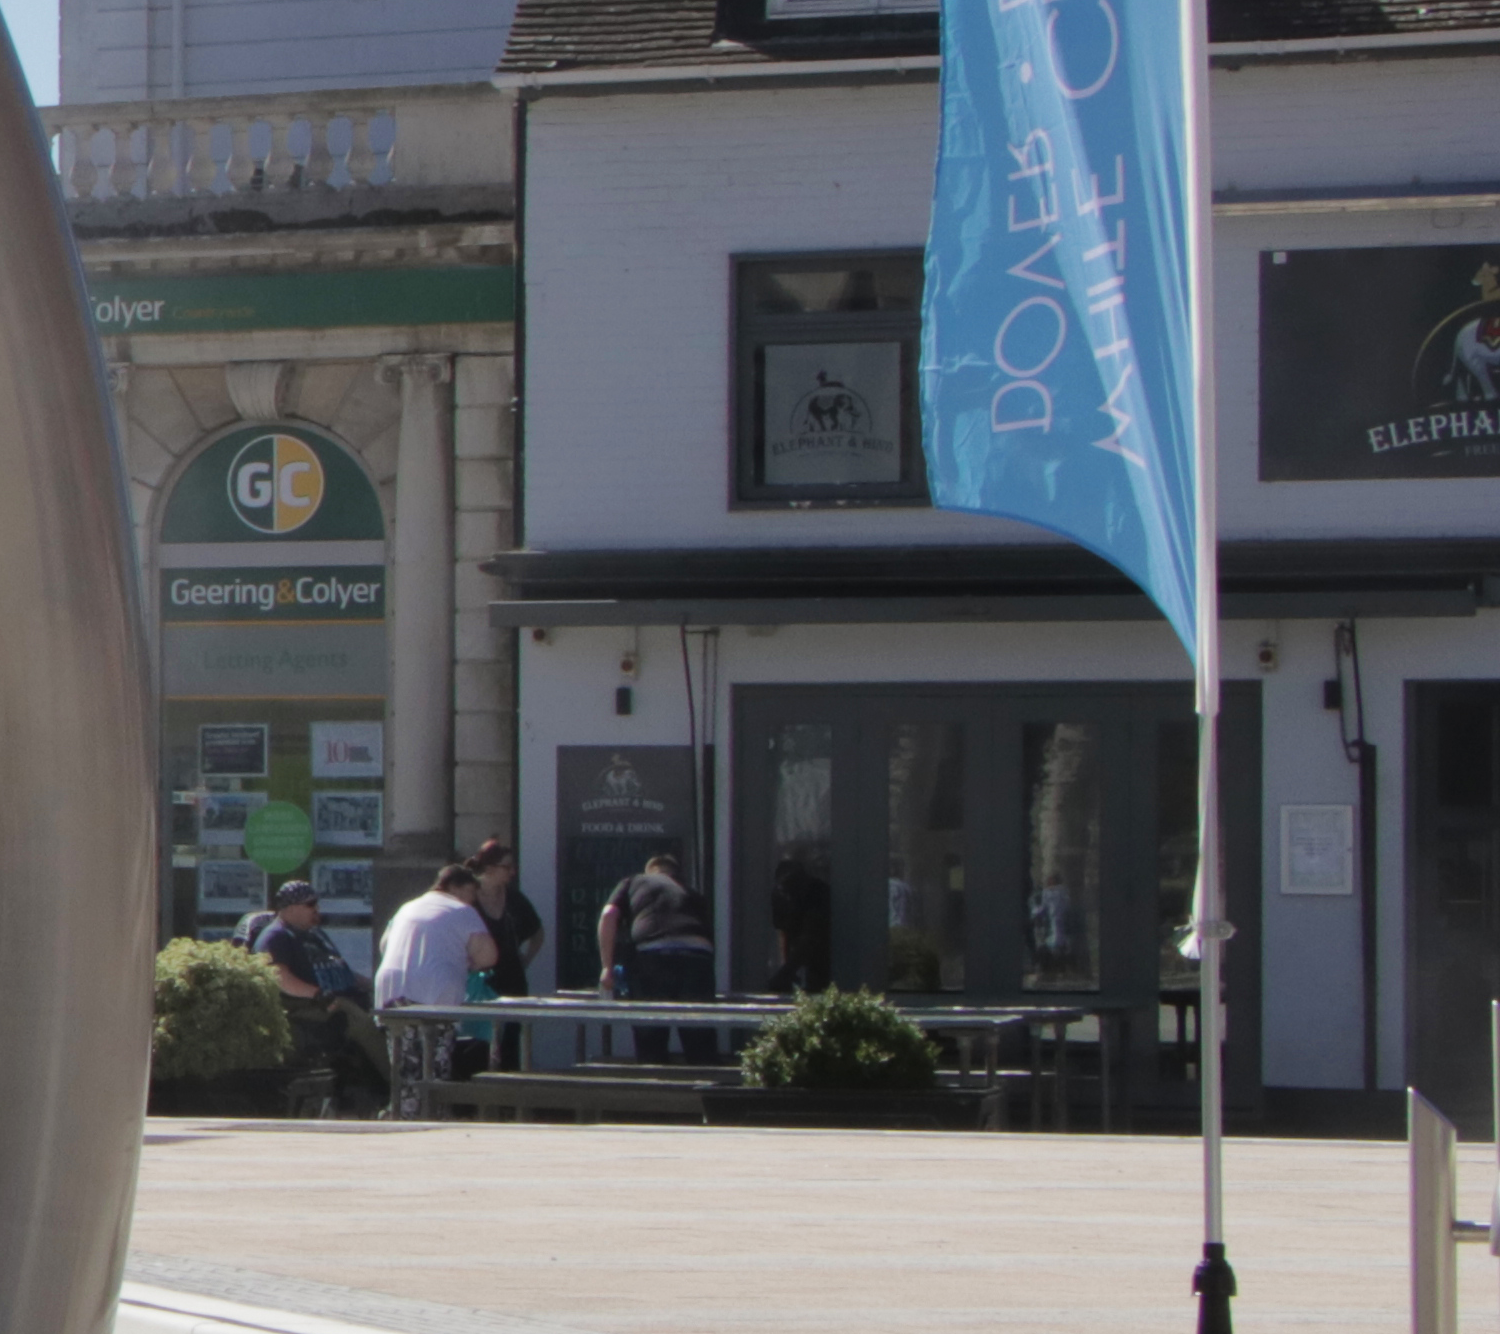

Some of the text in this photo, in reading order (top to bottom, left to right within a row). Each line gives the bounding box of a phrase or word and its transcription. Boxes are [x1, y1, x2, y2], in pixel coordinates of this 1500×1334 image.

[90, 295, 165, 328] olyer
[1367, 409, 1500, 453] ELEPHA
[772, 436, 842, 456] ELEPHANT
[236, 461, 311, 508] GC
[278, 650, 348, 674] Agents
[582, 797, 630, 812] ELEPHANT
[581, 821, 613, 833] FOOD
[627, 821, 664, 834] DRINK
